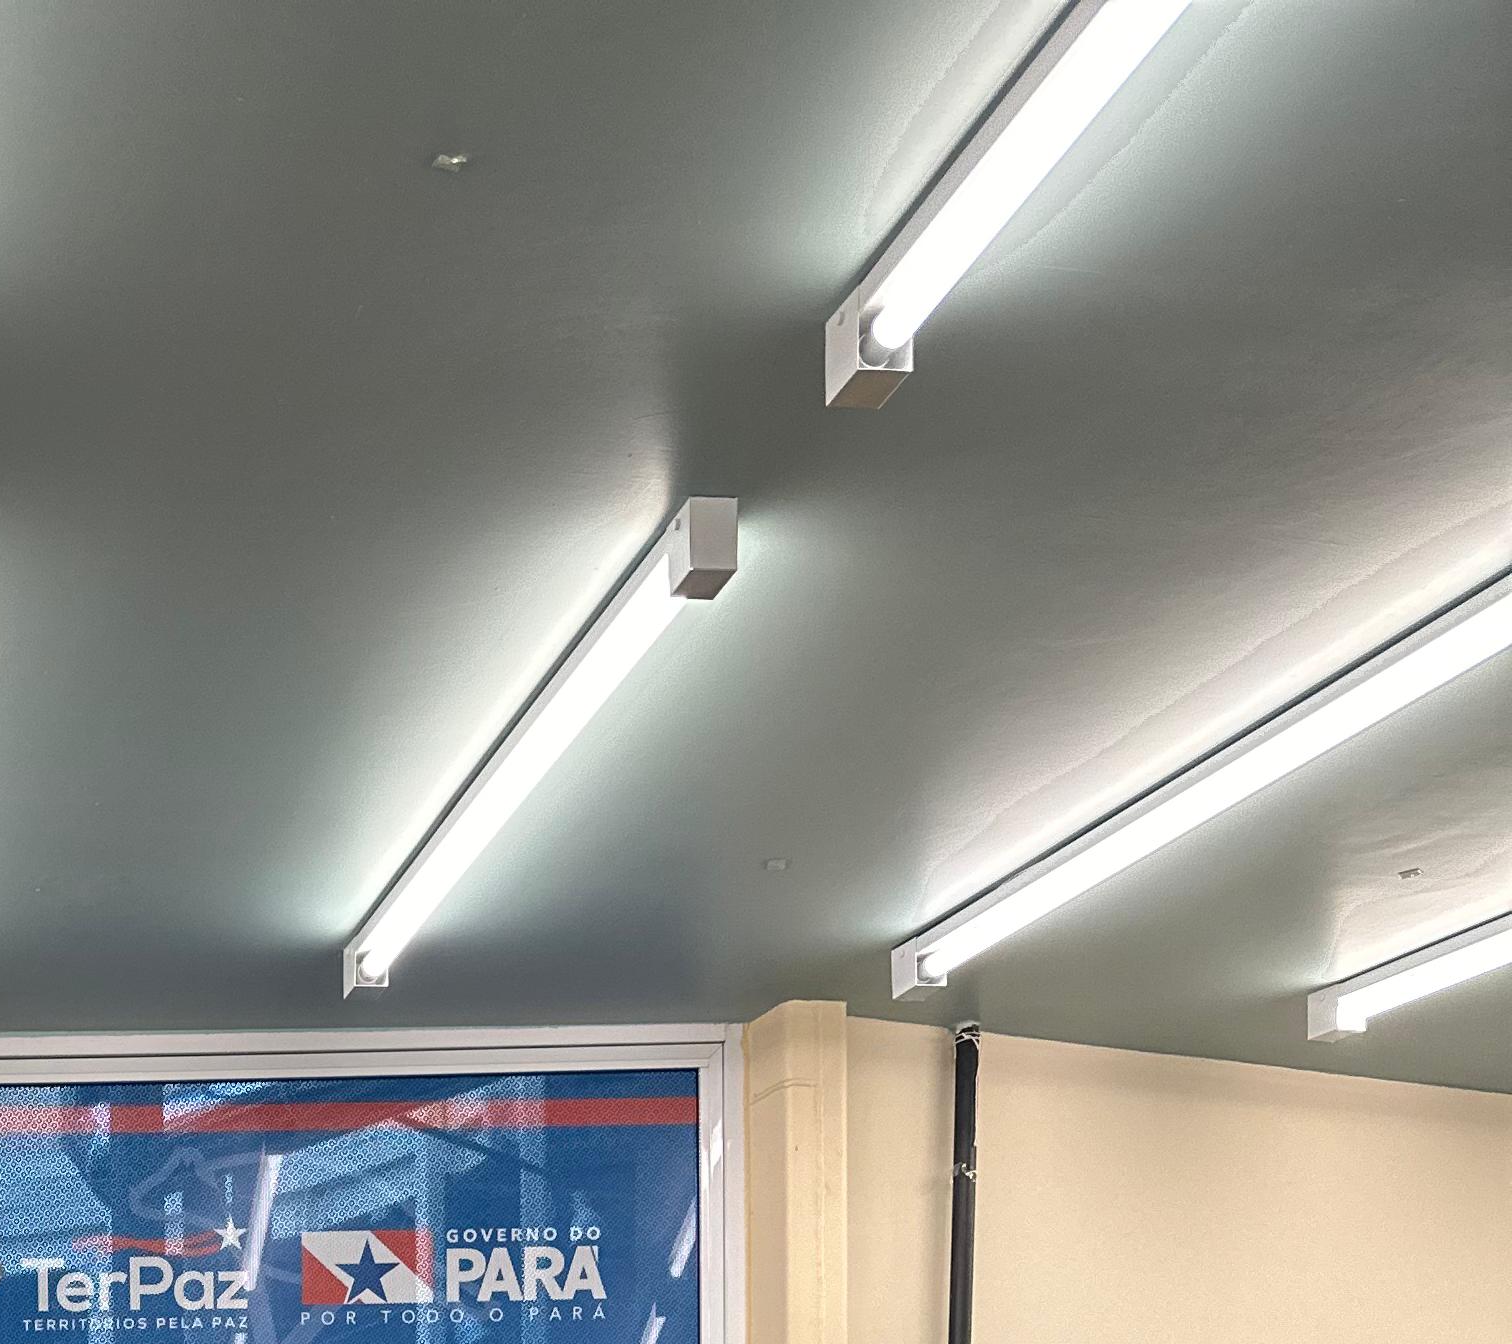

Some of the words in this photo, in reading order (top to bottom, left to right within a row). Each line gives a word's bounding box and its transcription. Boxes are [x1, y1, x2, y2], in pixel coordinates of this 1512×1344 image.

[446, 1226, 557, 1243] GOVERNO
[569, 1226, 601, 1241] DO
[20, 1255, 249, 1312] TerPaz
[156, 1316, 204, 1330] PELA
[211, 1316, 249, 1329] PAZ
[300, 1310, 357, 1326] POR
[380, 1308, 465, 1325] TODO
[489, 1307, 504, 1323] O
[529, 1303, 606, 1321] PARÁ
